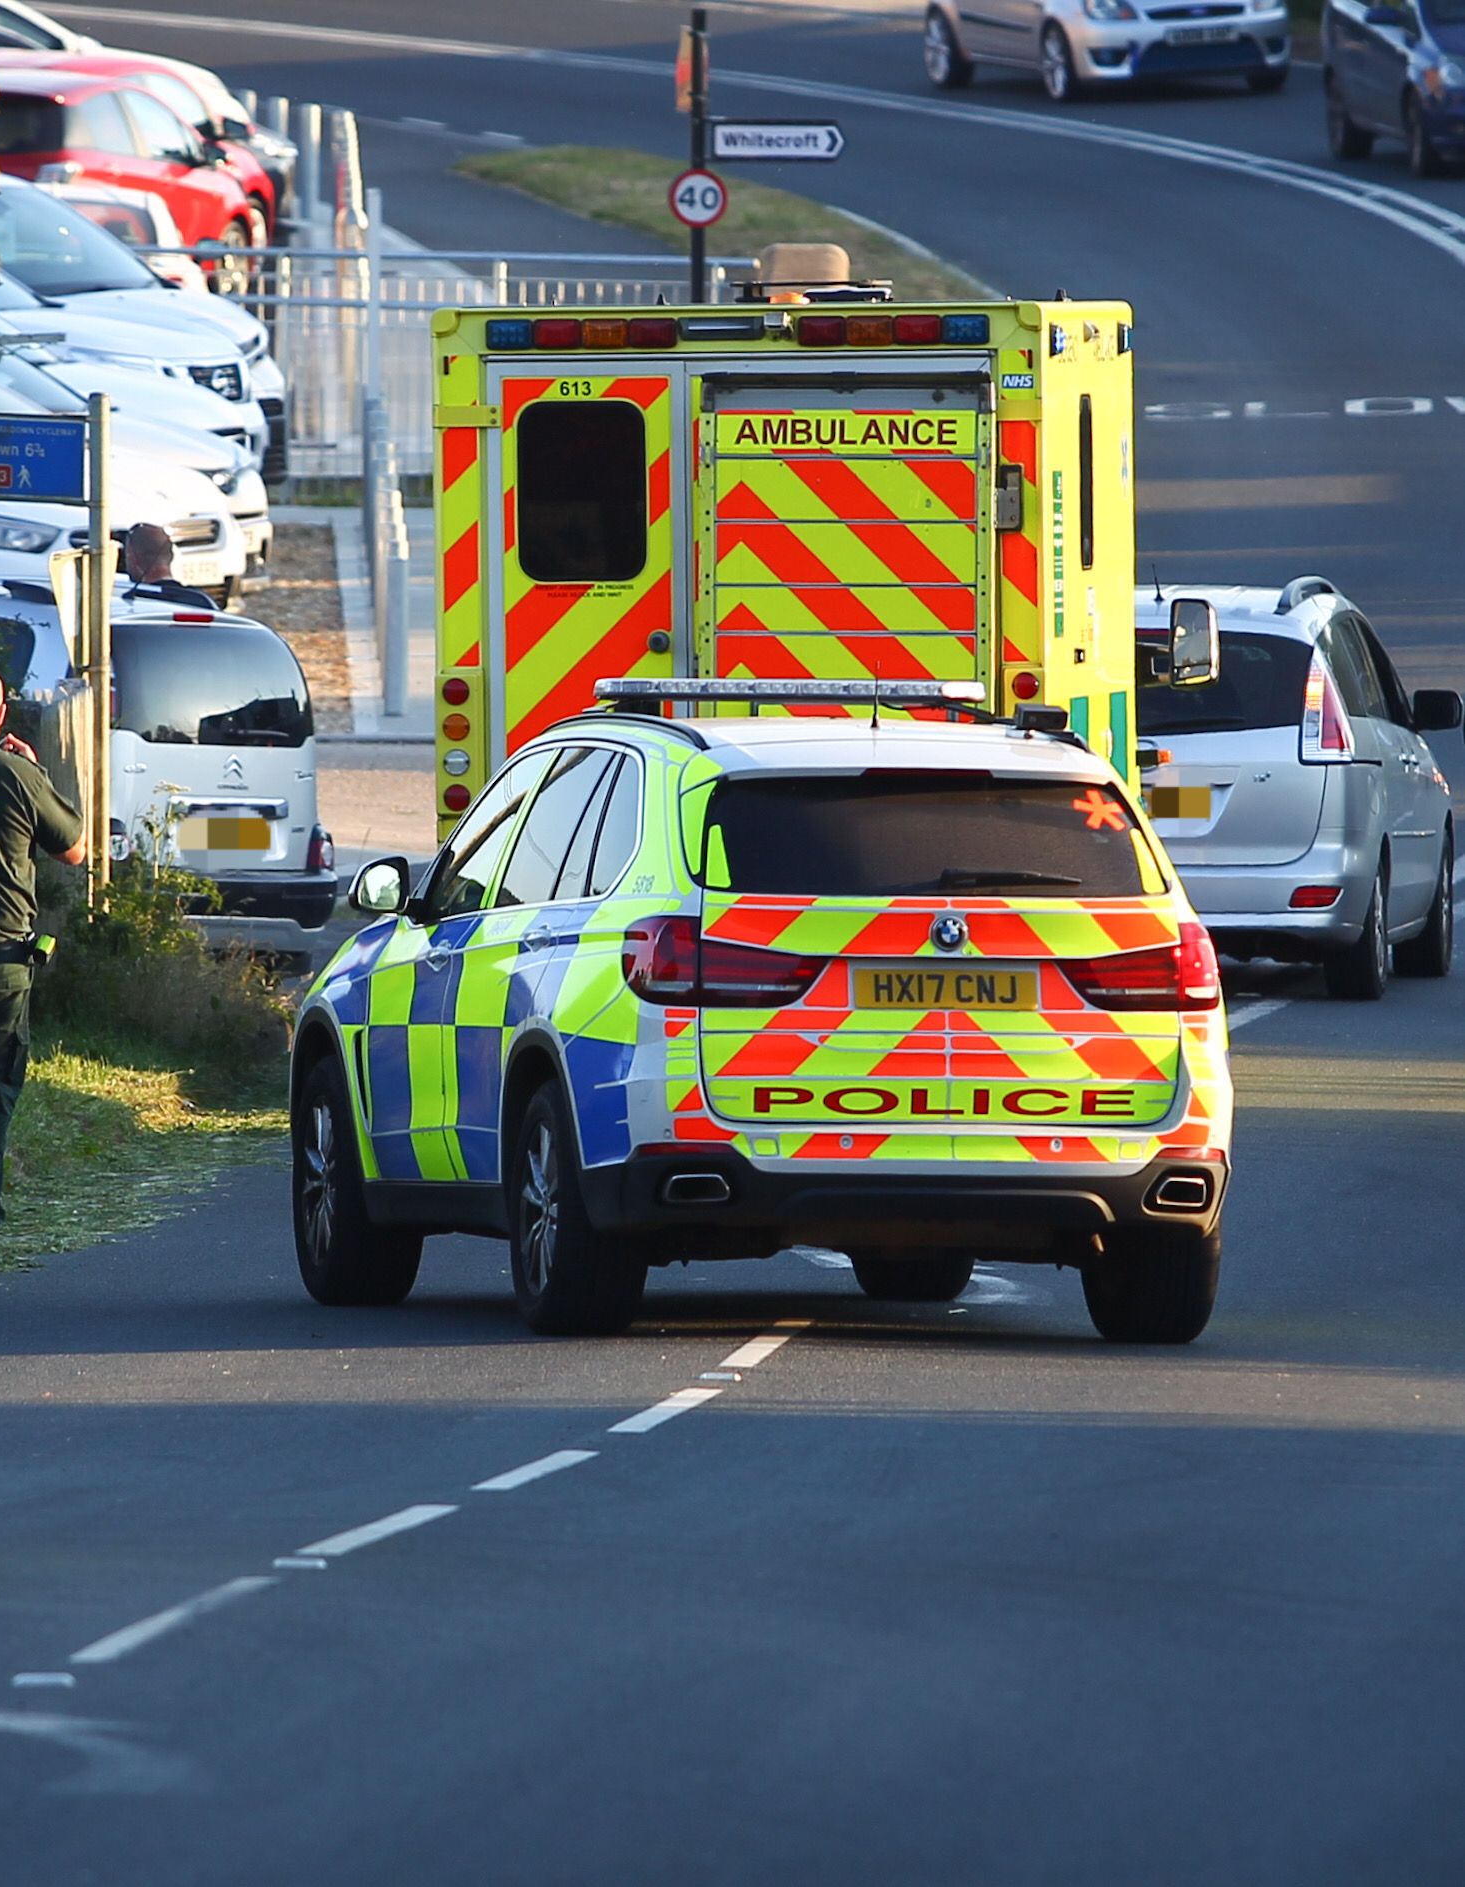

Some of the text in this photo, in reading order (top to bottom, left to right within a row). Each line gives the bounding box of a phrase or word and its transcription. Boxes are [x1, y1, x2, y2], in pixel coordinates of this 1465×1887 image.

[722, 132, 819, 149] Whitecroft
[678, 186, 719, 211] 40
[560, 381, 592, 396] 613
[1003, 375, 1033, 387] NHS
[1144, 397, 1465, 421] SLO
[36, 426, 78, 437] CYCLEWAY
[734, 419, 958, 446] AMBULANCE
[873, 973, 1018, 1004] HX17 CNJ
[753, 1086, 1136, 1116] POLICE
